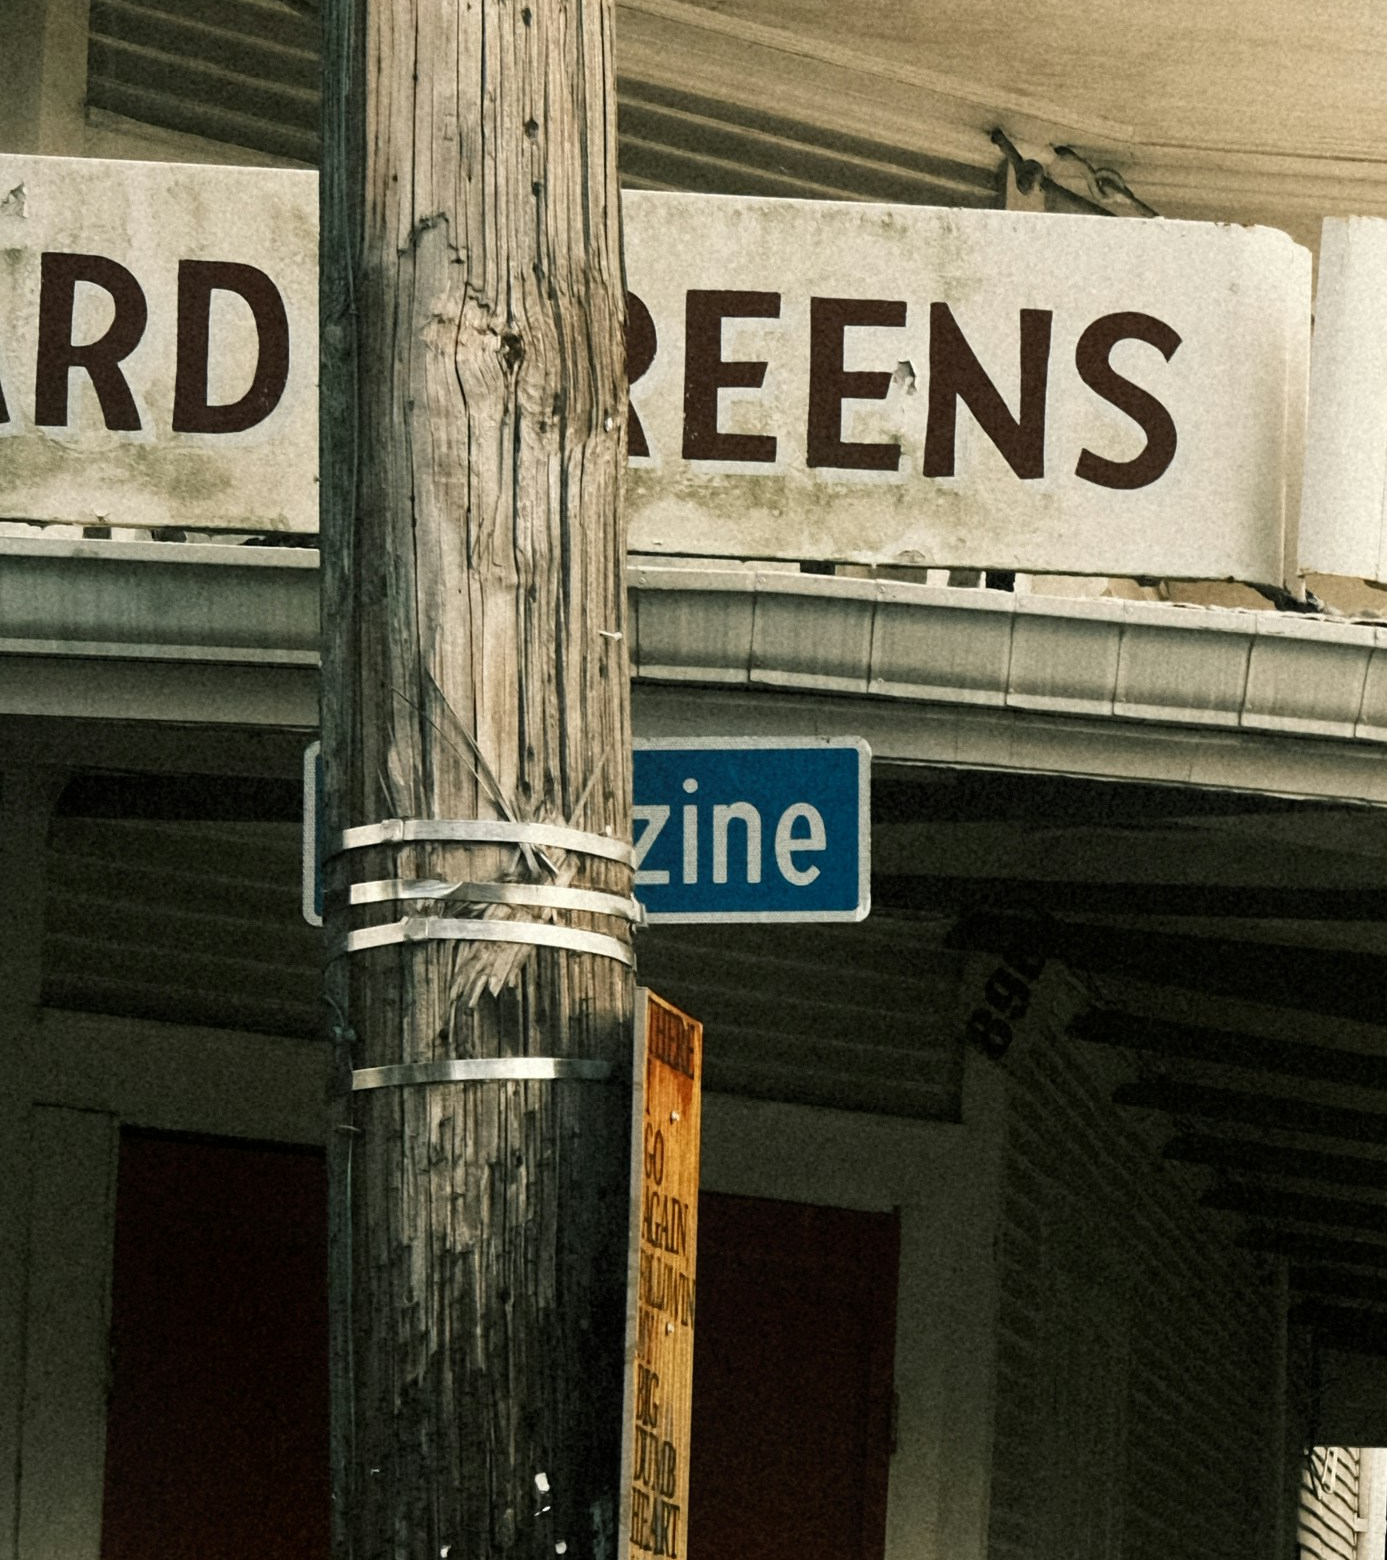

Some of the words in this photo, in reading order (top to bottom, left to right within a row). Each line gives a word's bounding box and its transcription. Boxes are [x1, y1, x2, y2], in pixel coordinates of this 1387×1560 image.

[0, 252, 290, 435] RD
[628, 289, 1183, 490] EENS
[647, 998, 696, 1081] THERE
[644, 1122, 665, 1187] GO
[641, 1185, 690, 1257] AGAIN
[635, 1362, 660, 1430] BIG
[632, 1423, 678, 1501] DUMB
[629, 1485, 681, 1560] HEART
